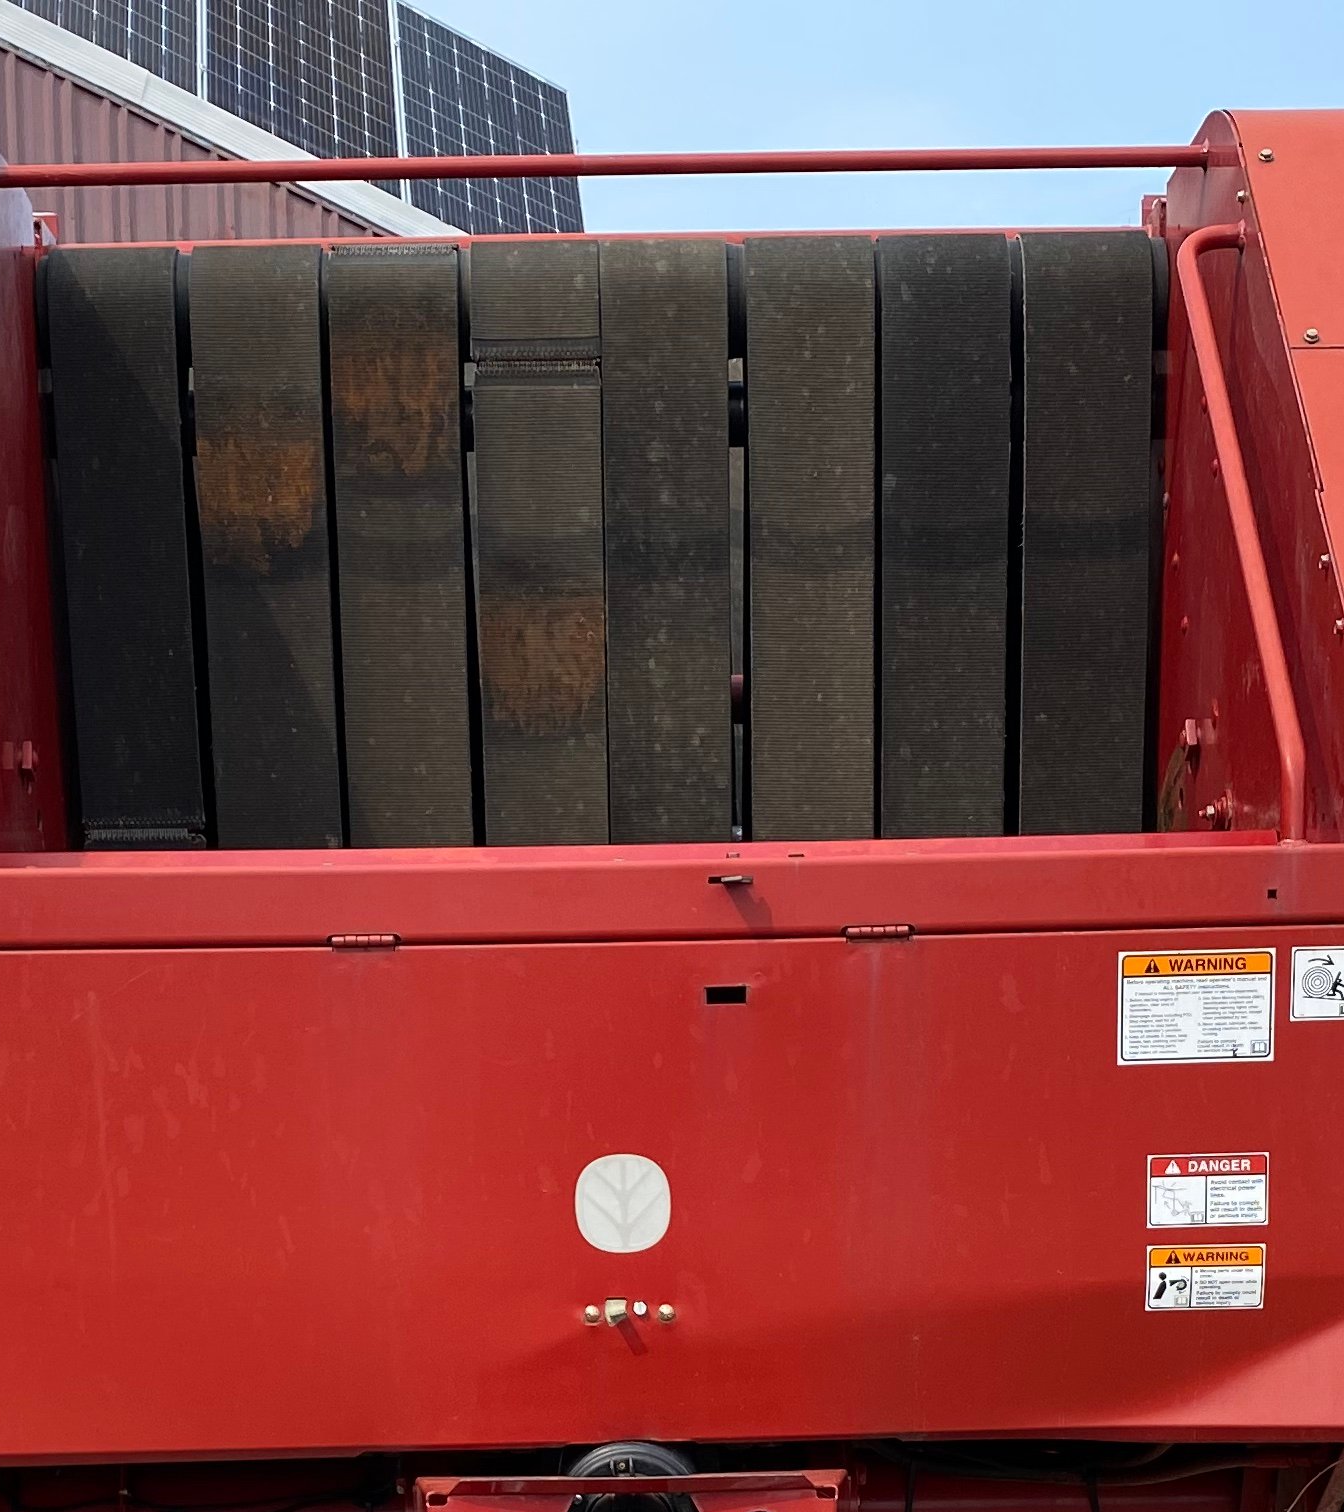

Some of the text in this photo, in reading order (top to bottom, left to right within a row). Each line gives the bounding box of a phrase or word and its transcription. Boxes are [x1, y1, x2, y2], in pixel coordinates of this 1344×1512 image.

[1169, 957, 1247, 972] WARNING
[1188, 1159, 1251, 1172] DANGER
[1183, 1251, 1249, 1261] WARNING
